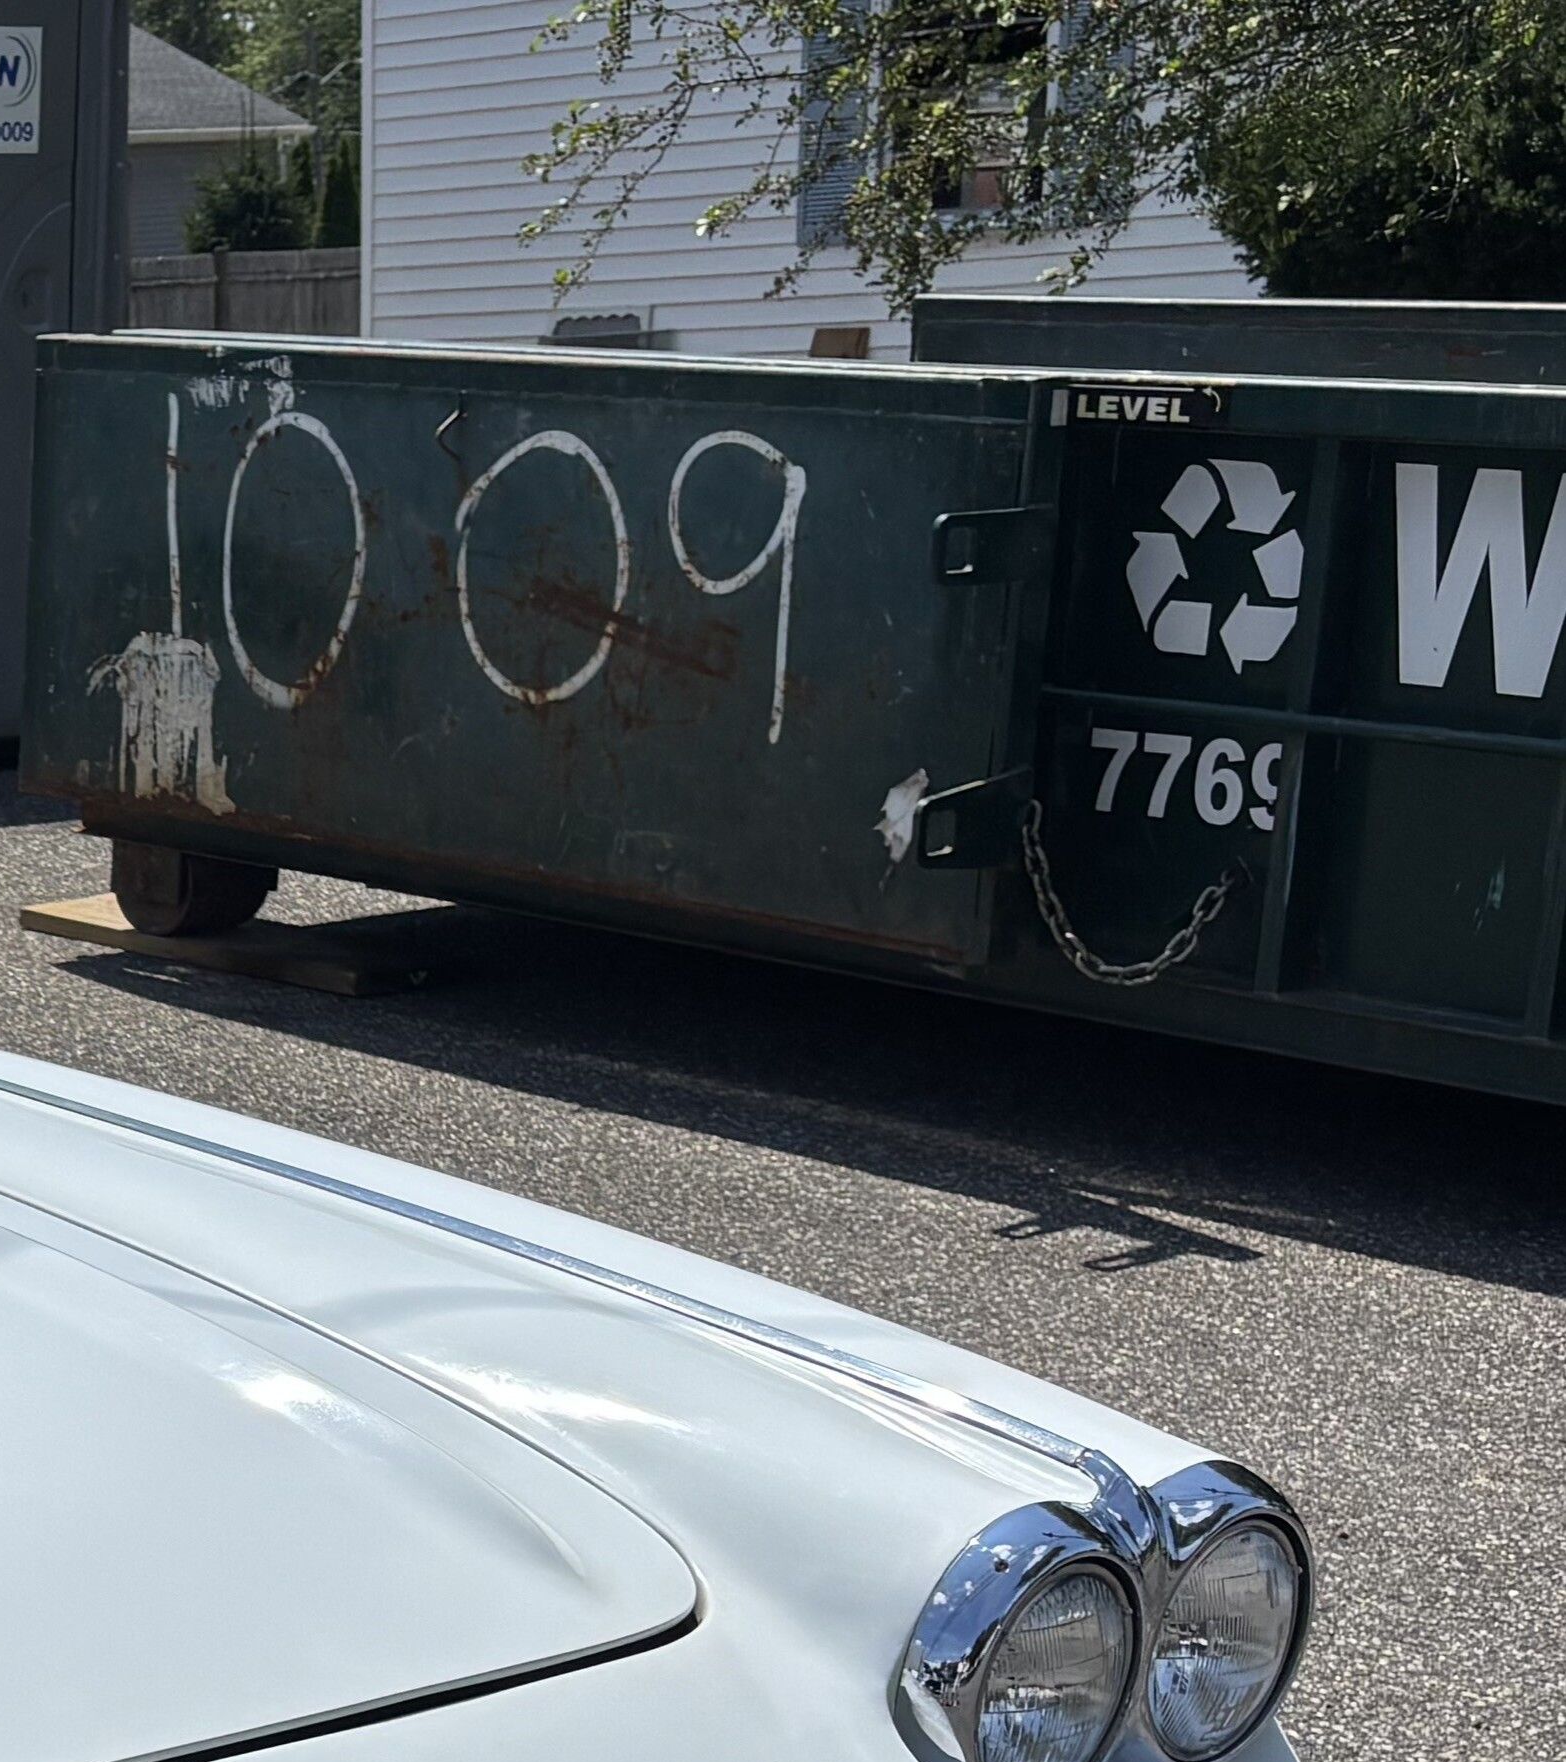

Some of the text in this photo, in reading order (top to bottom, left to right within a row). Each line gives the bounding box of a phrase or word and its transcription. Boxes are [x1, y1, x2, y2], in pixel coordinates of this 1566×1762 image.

[1076, 394, 1190, 423] LEVEL
[165, 391, 807, 745] 1009
[1090, 727, 1283, 832] 7769
